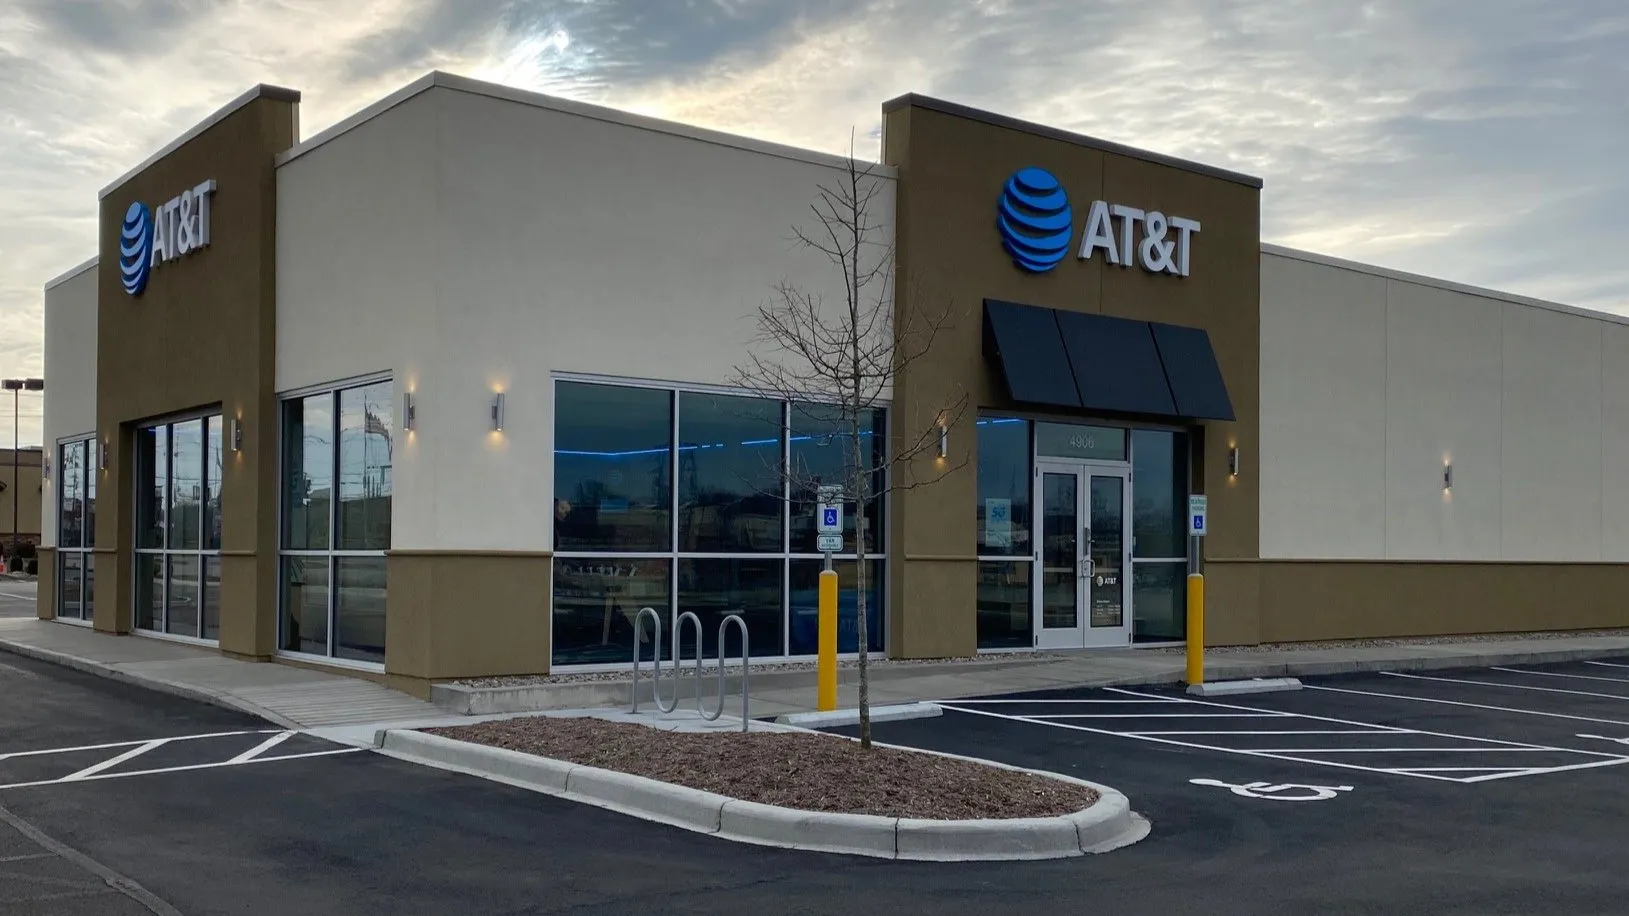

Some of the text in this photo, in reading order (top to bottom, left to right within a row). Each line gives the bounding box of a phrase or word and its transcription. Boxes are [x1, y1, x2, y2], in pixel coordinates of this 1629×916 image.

[150, 179, 217, 267] AT&T
[1077, 200, 1201, 277] AT&T
[1070, 434, 1095, 449] 4906
[1104, 577, 1117, 585] AT&T
